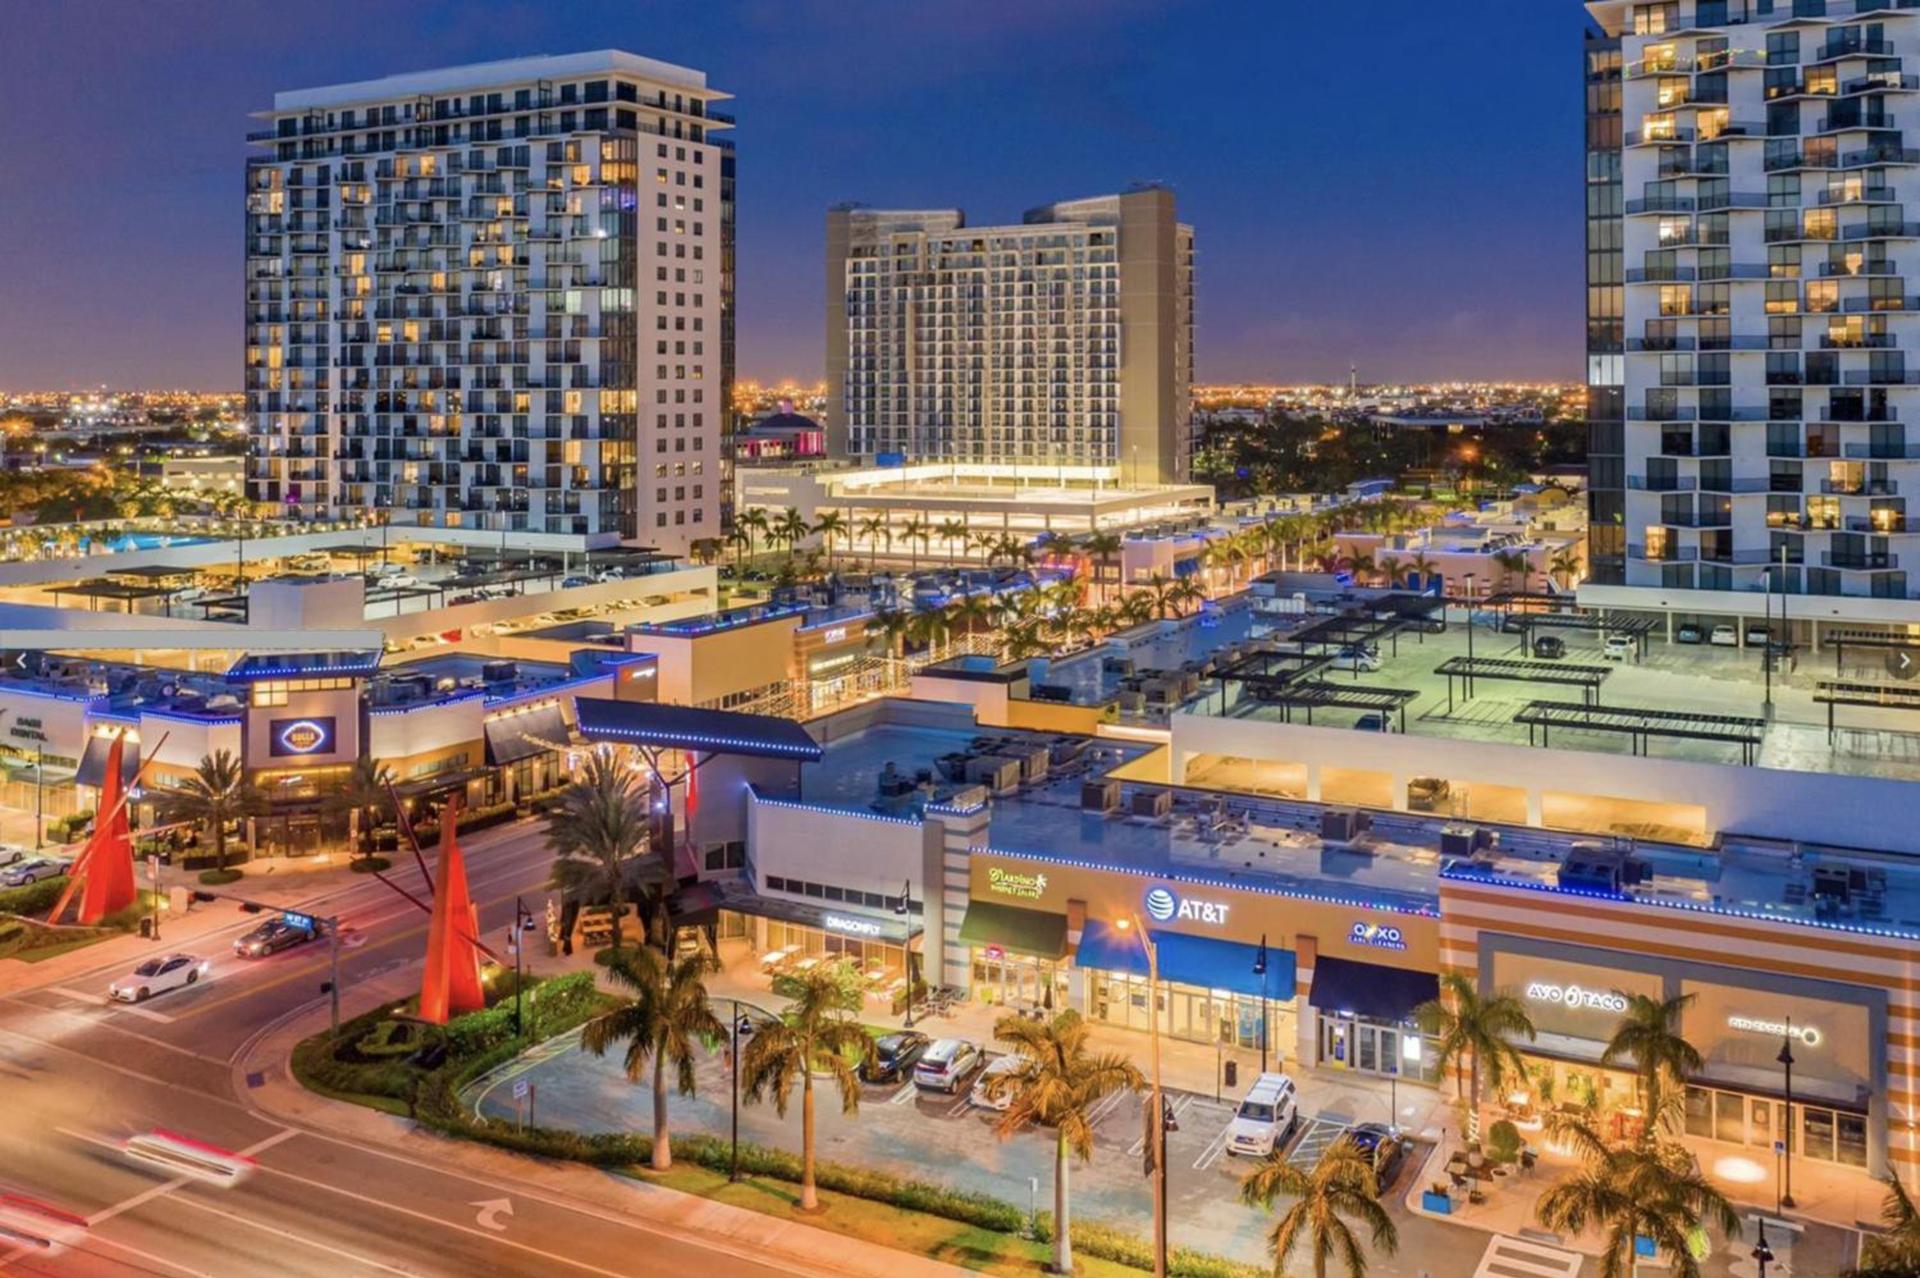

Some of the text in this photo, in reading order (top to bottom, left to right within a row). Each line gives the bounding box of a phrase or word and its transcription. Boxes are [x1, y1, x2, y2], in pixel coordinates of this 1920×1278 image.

[1177, 898, 1230, 924] AT&T
[1528, 983, 1627, 1013] AVO TACO
